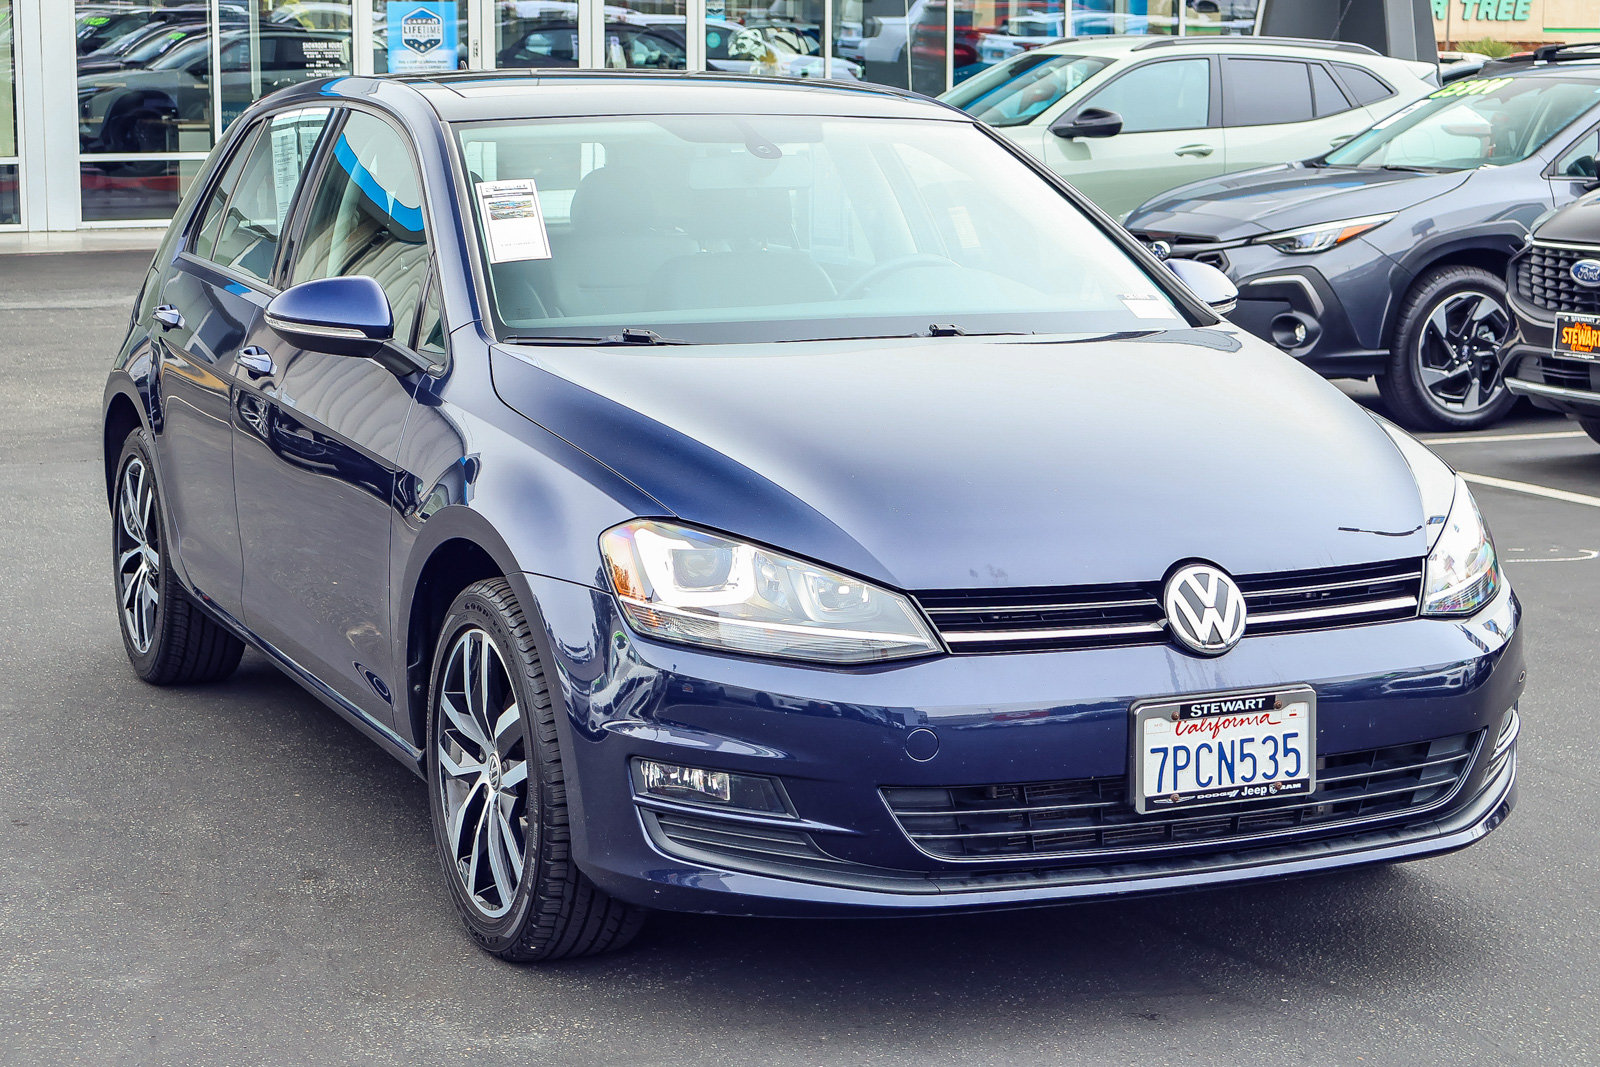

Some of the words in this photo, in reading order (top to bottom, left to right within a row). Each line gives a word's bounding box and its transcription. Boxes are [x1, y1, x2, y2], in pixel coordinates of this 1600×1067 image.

[1460, 0, 1532, 21] TREE
[403, 26, 441, 34] LIFETIME
[1190, 698, 1266, 717] STEWART
[1175, 713, 1282, 740] California
[1149, 732, 1301, 793] 7PCN535
[1240, 785, 1268, 797] Jeep
